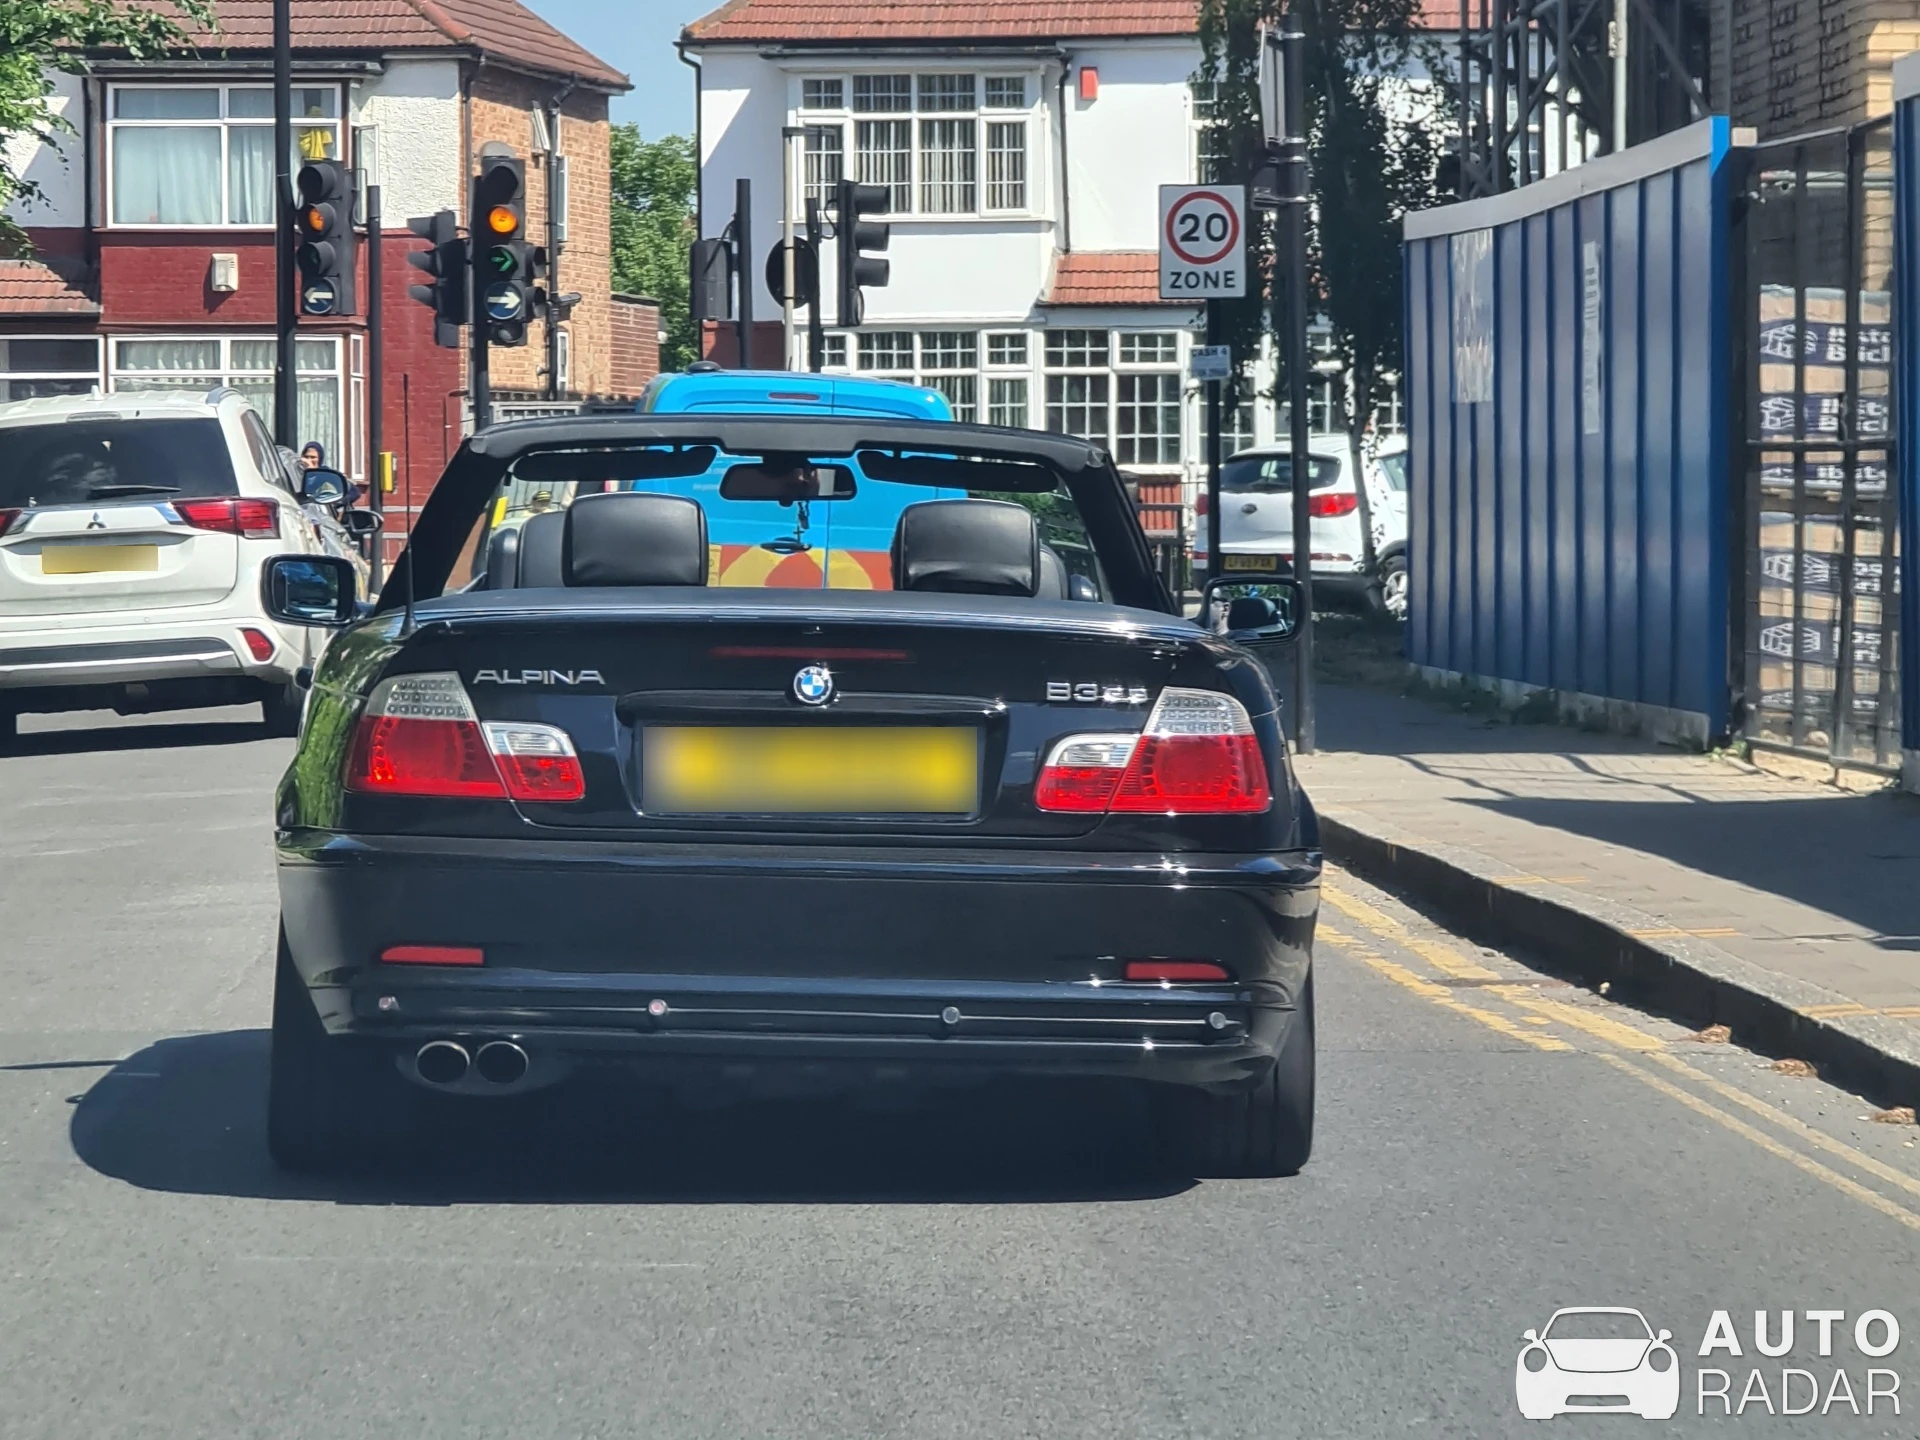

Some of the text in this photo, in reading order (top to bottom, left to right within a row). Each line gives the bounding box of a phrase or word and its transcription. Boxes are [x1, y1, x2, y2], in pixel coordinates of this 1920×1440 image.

[1179, 213, 1229, 242] 20
[1169, 270, 1236, 289] ZONE
[473, 669, 606, 685] ALPINA
